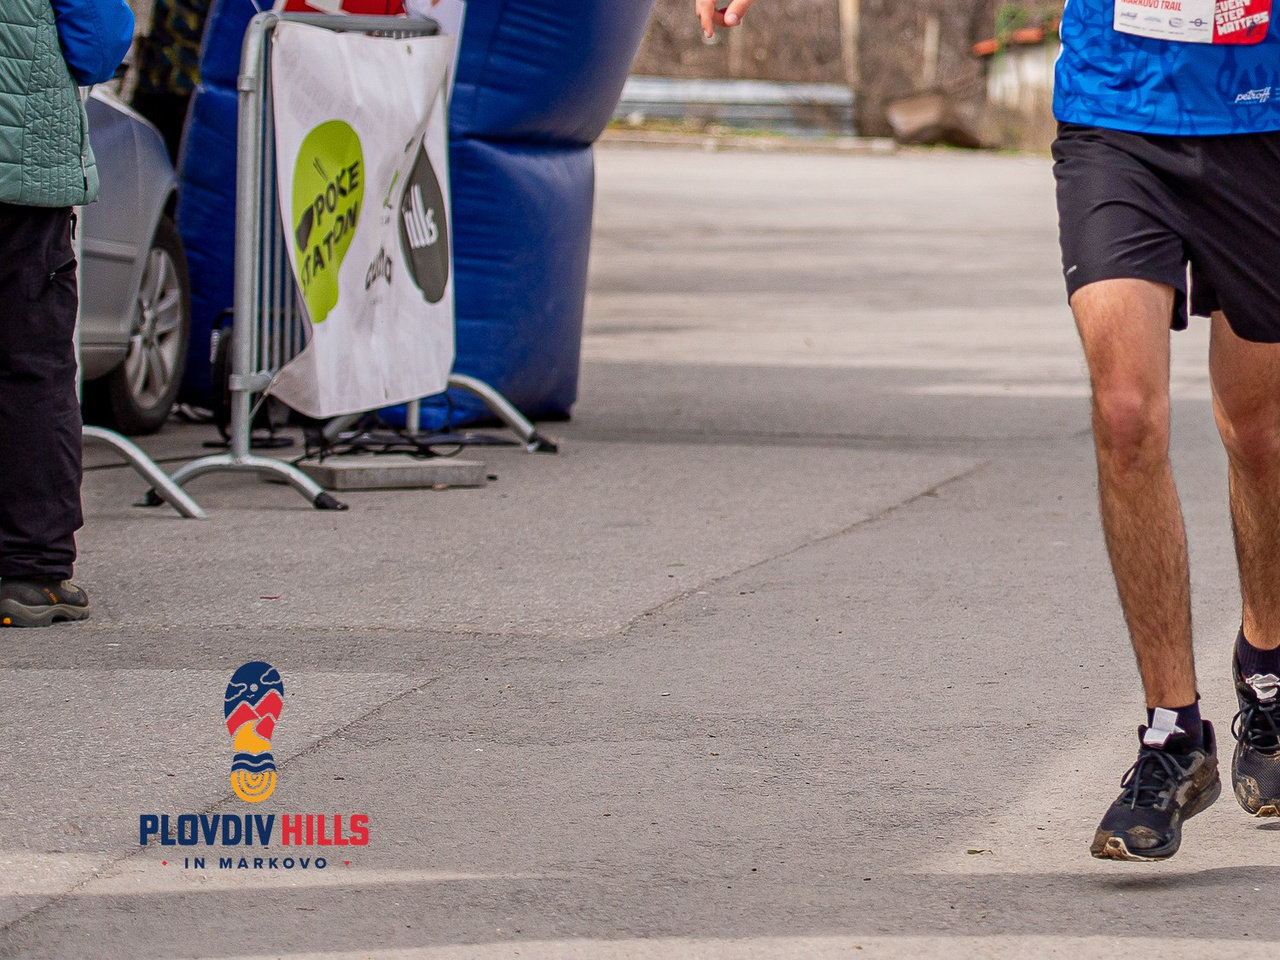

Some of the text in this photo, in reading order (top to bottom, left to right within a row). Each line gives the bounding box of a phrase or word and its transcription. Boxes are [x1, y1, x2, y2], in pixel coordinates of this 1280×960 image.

[1160, 0, 1183, 12] TRAIL
[1215, 6, 1246, 26] STEP
[312, 158, 361, 227] POKE
